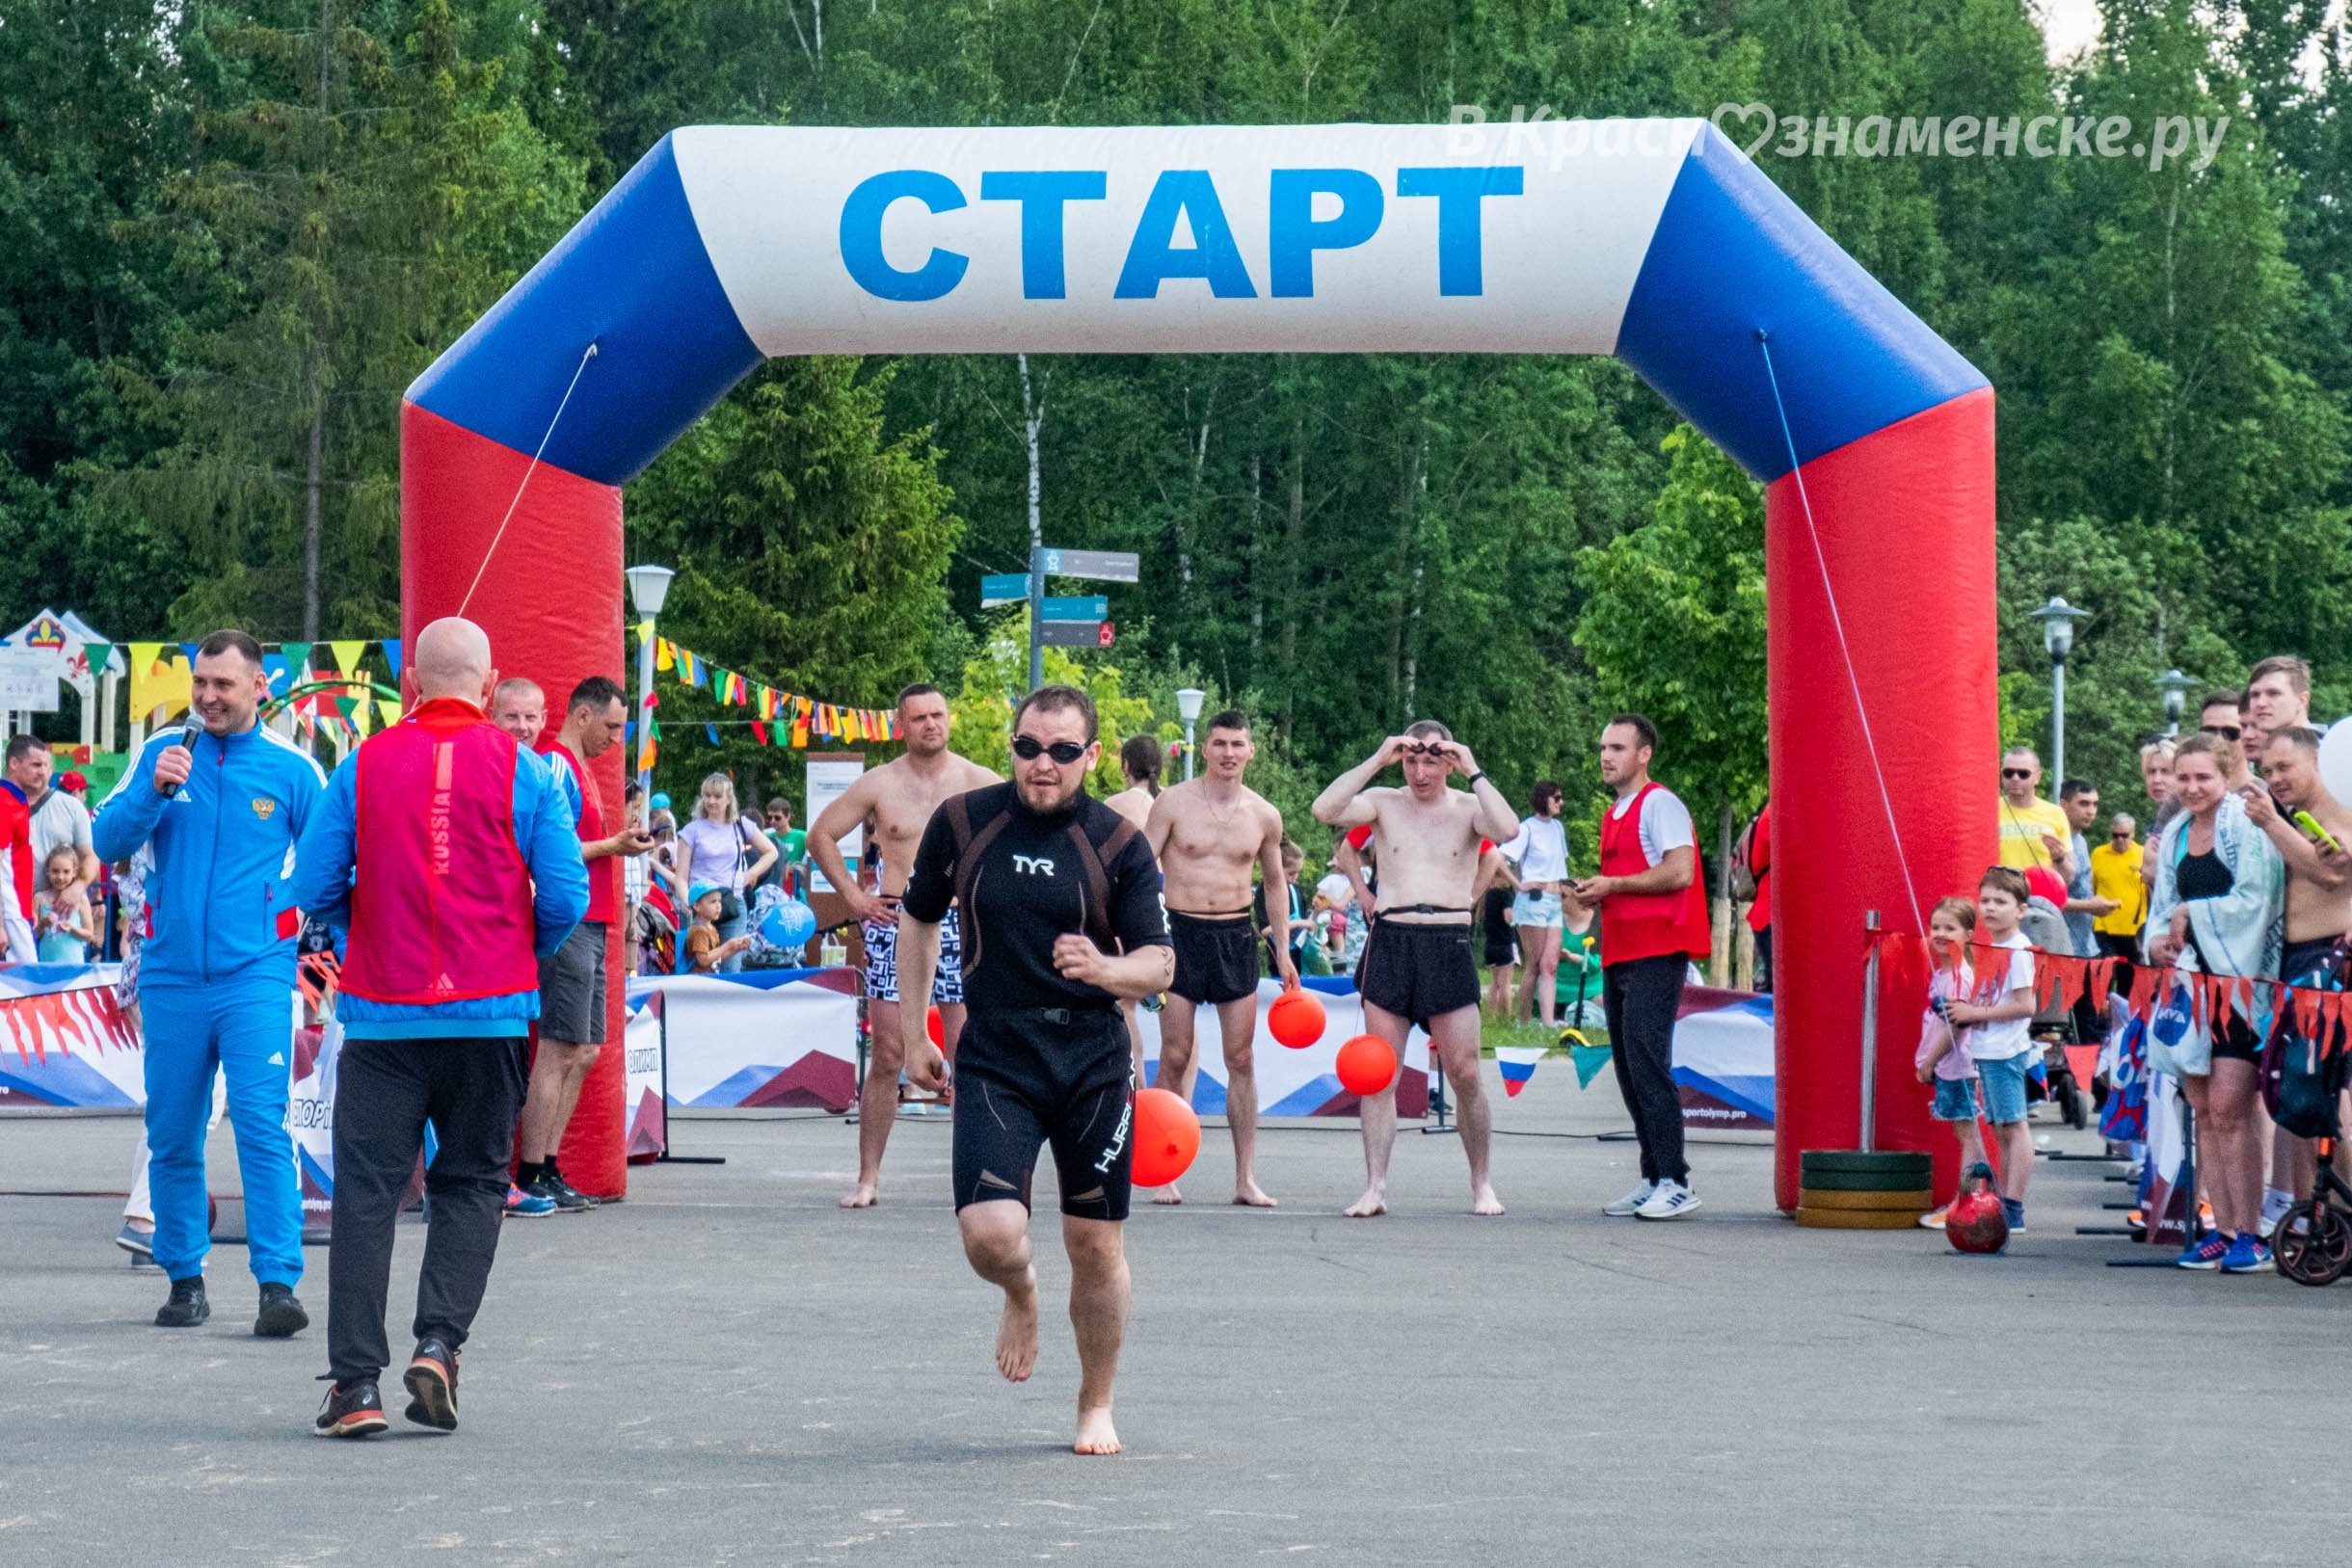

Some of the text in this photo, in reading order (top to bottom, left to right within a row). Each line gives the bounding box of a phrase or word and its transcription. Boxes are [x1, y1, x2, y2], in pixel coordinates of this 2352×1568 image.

[839, 166, 1525, 303] СТАРТ
[430, 791, 451, 876] RUSSIA
[1012, 854, 1055, 877] TYR
[627, 1047, 658, 1076] ОЛИМП
